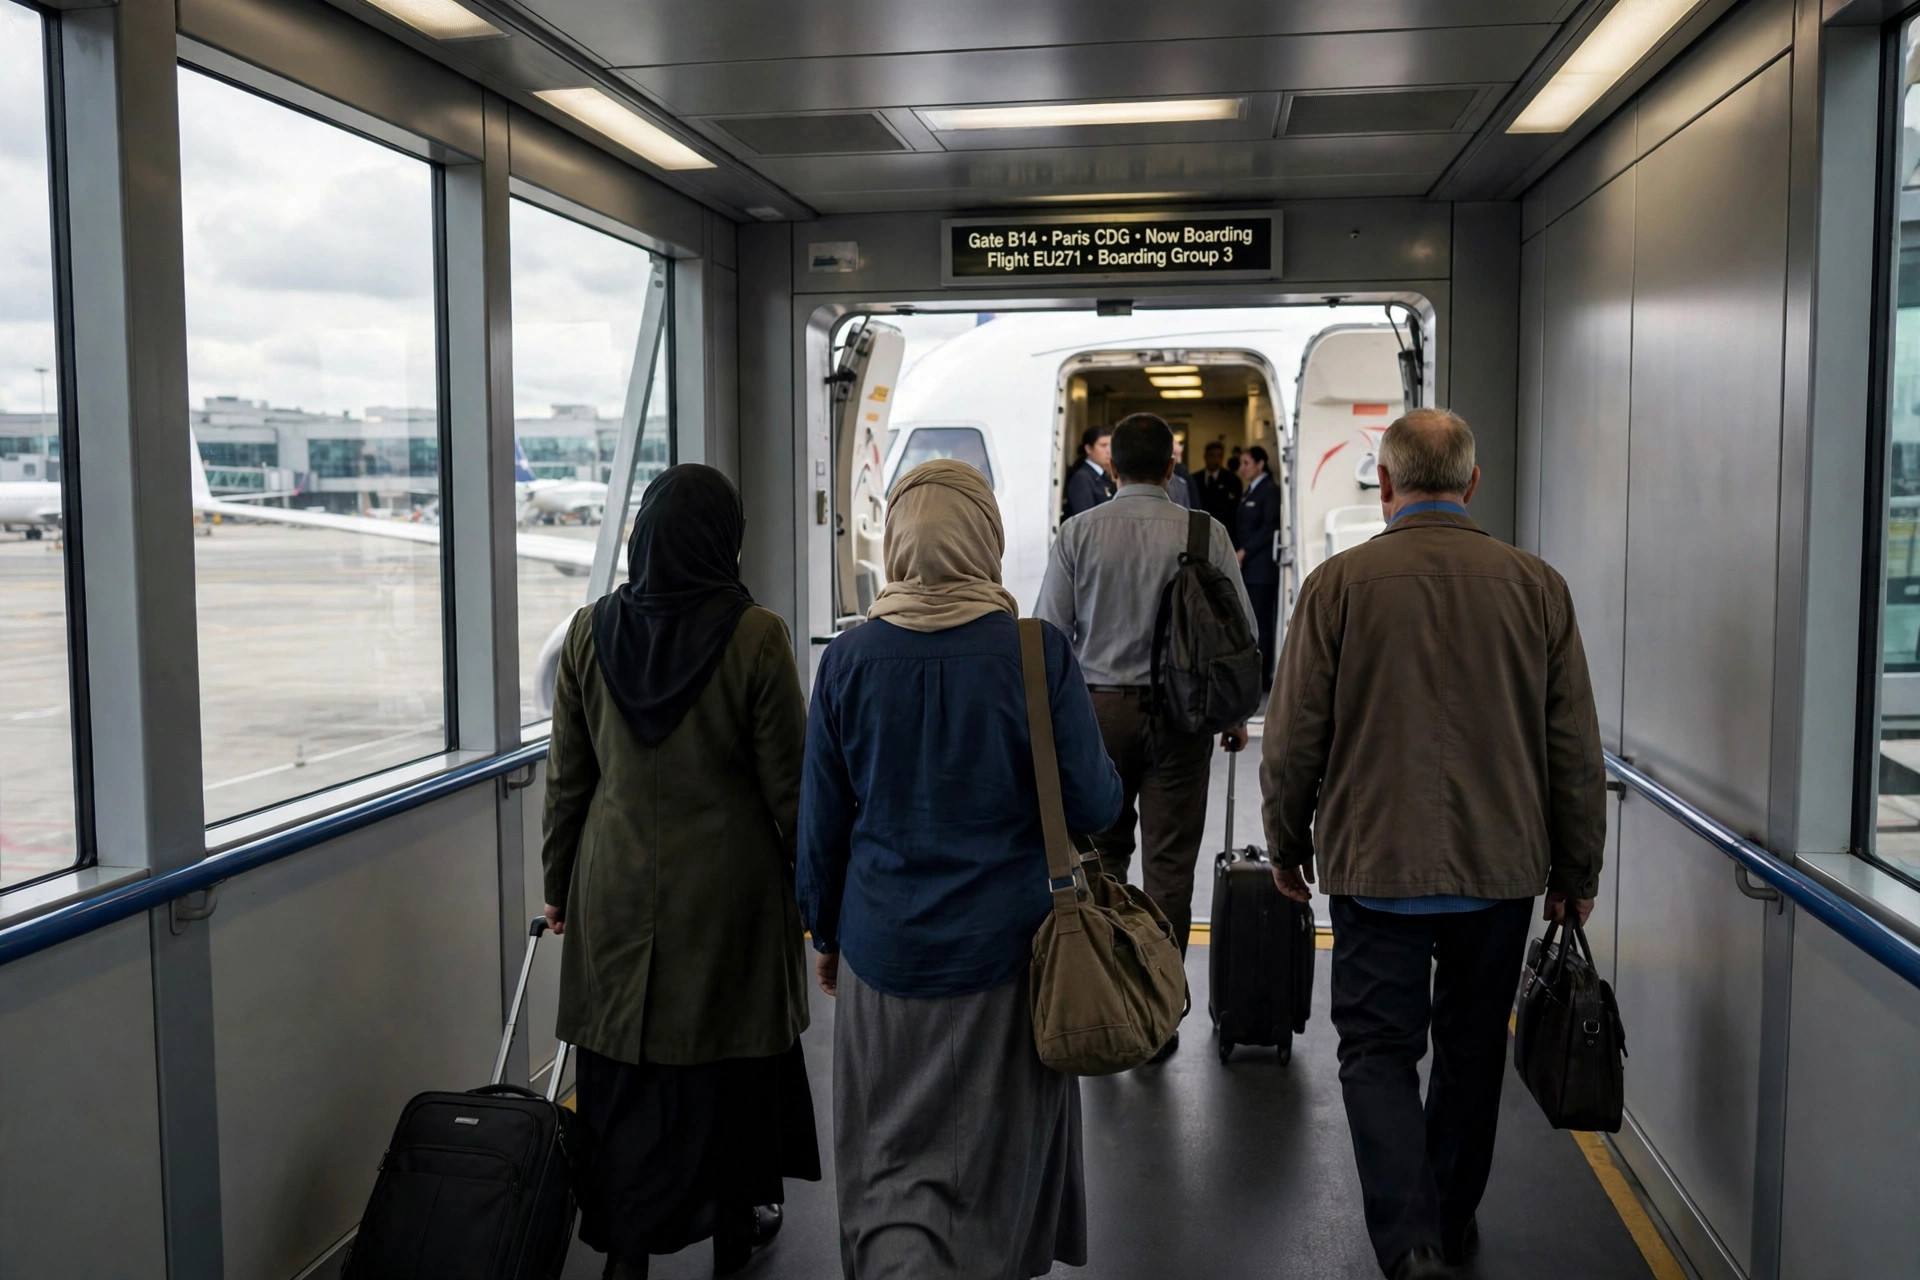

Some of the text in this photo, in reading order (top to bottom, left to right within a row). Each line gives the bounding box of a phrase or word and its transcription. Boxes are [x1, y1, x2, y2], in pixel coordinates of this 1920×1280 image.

[968, 226, 1253, 249] Gate B14 Paris CDG Now Boarding
[987, 247, 1233, 271] Flight EU271 Boarding Group 3
